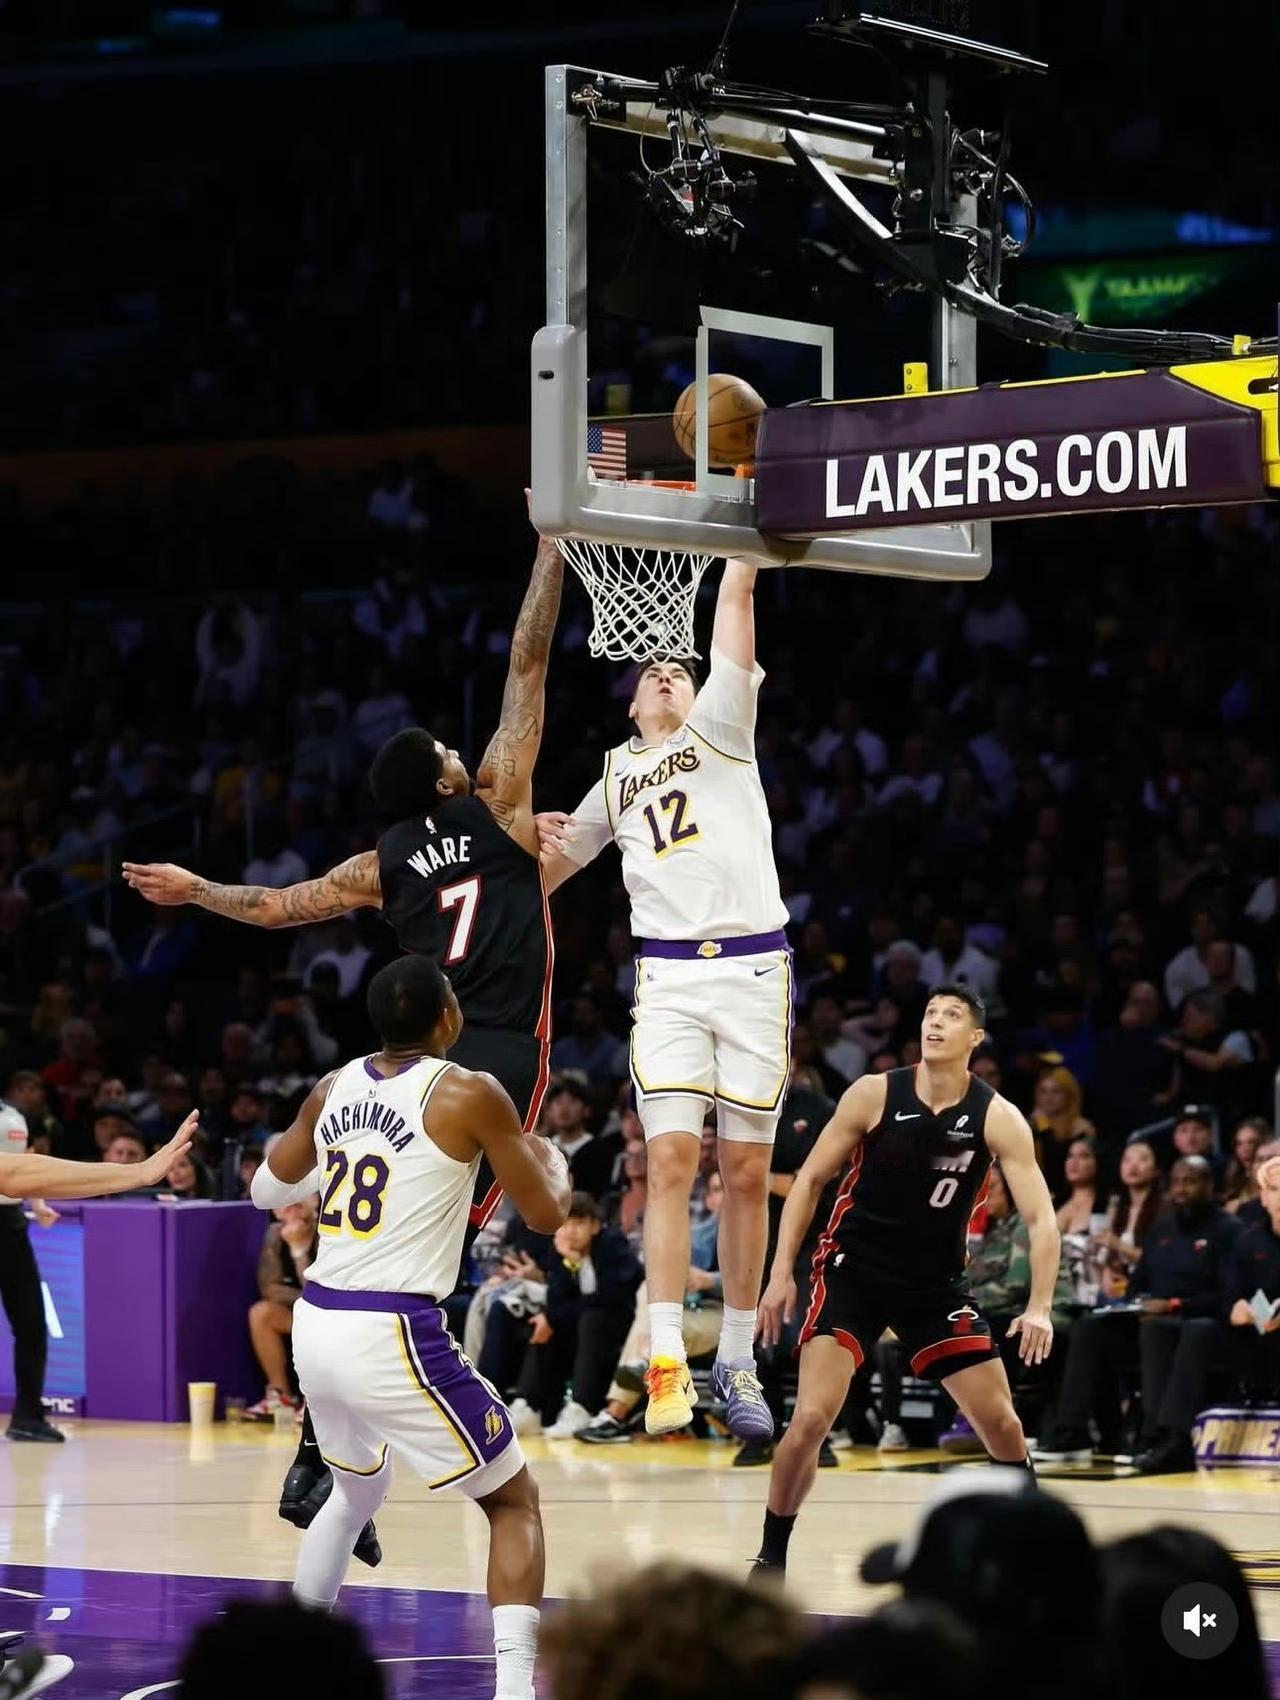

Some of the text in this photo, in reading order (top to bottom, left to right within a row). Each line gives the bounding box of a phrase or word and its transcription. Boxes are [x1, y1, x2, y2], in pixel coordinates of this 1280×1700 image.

[825, 426, 1187, 519] LAKERS.COM
[619, 746, 701, 816] LAKERS
[406, 835, 471, 878] WARE
[643, 789, 701, 860] 12
[436, 874, 482, 966] 7
[320, 1102, 415, 1153] HACHIMURA
[319, 1150, 390, 1240] 28
[929, 1178, 959, 1208] 0
